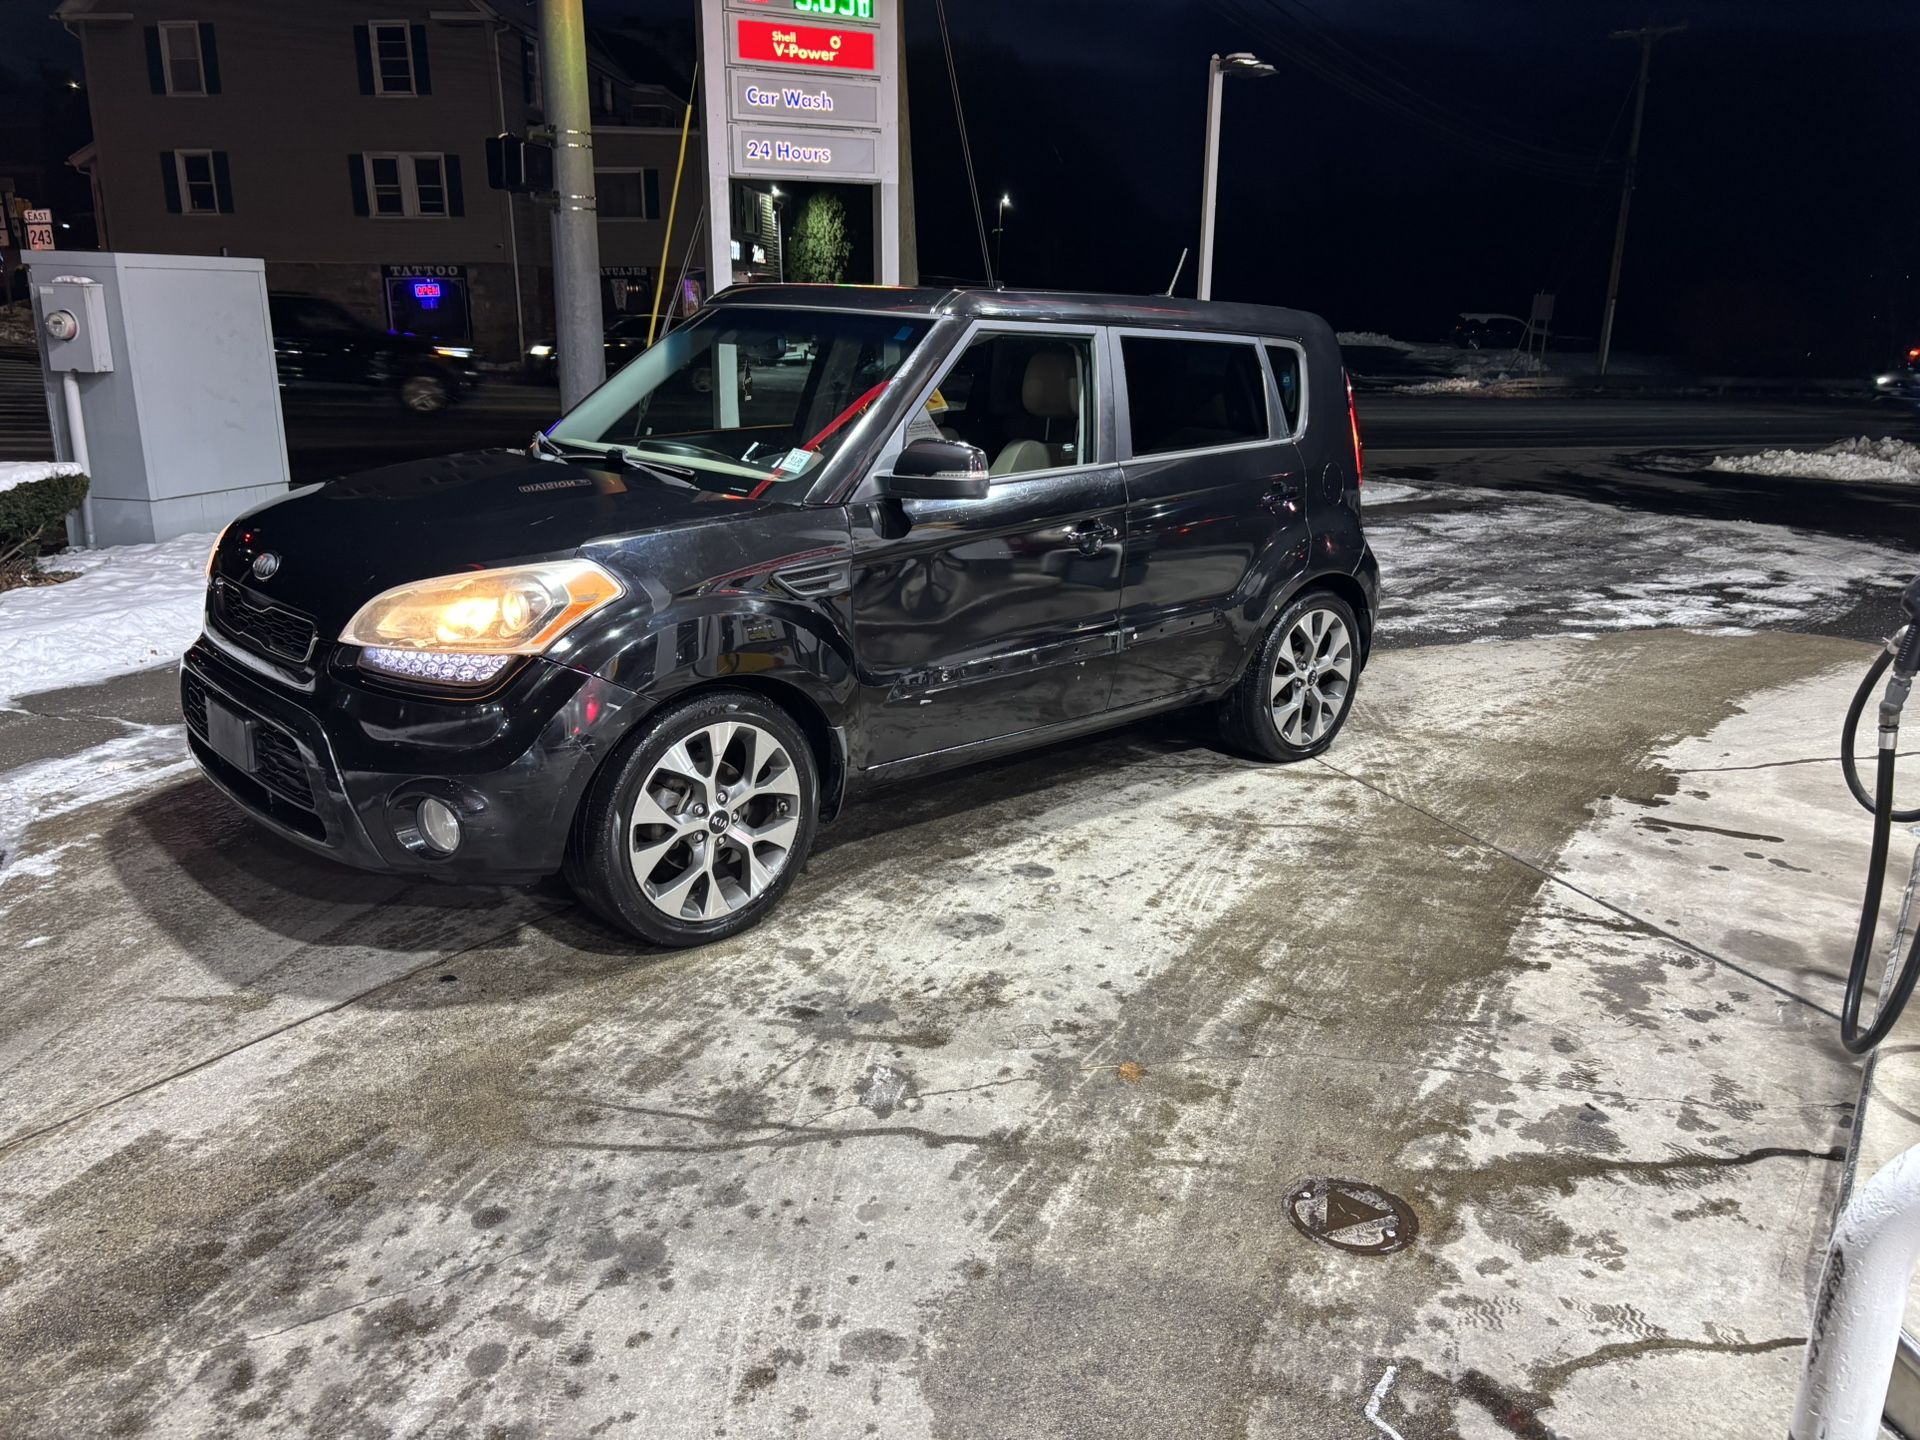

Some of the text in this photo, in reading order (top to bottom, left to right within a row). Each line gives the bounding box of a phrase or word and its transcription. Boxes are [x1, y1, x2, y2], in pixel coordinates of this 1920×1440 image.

[771, 31, 797, 43] Shell
[773, 43, 837, 62] V-Power
[746, 86, 833, 110] Car Wash
[747, 140, 831, 162] 24 Hours
[28, 211, 47, 221] EAST
[30, 230, 52, 245] 243
[390, 265, 458, 276] TATTOO
[416, 286, 438, 295] OPEN
[712, 816, 728, 828] KIA
